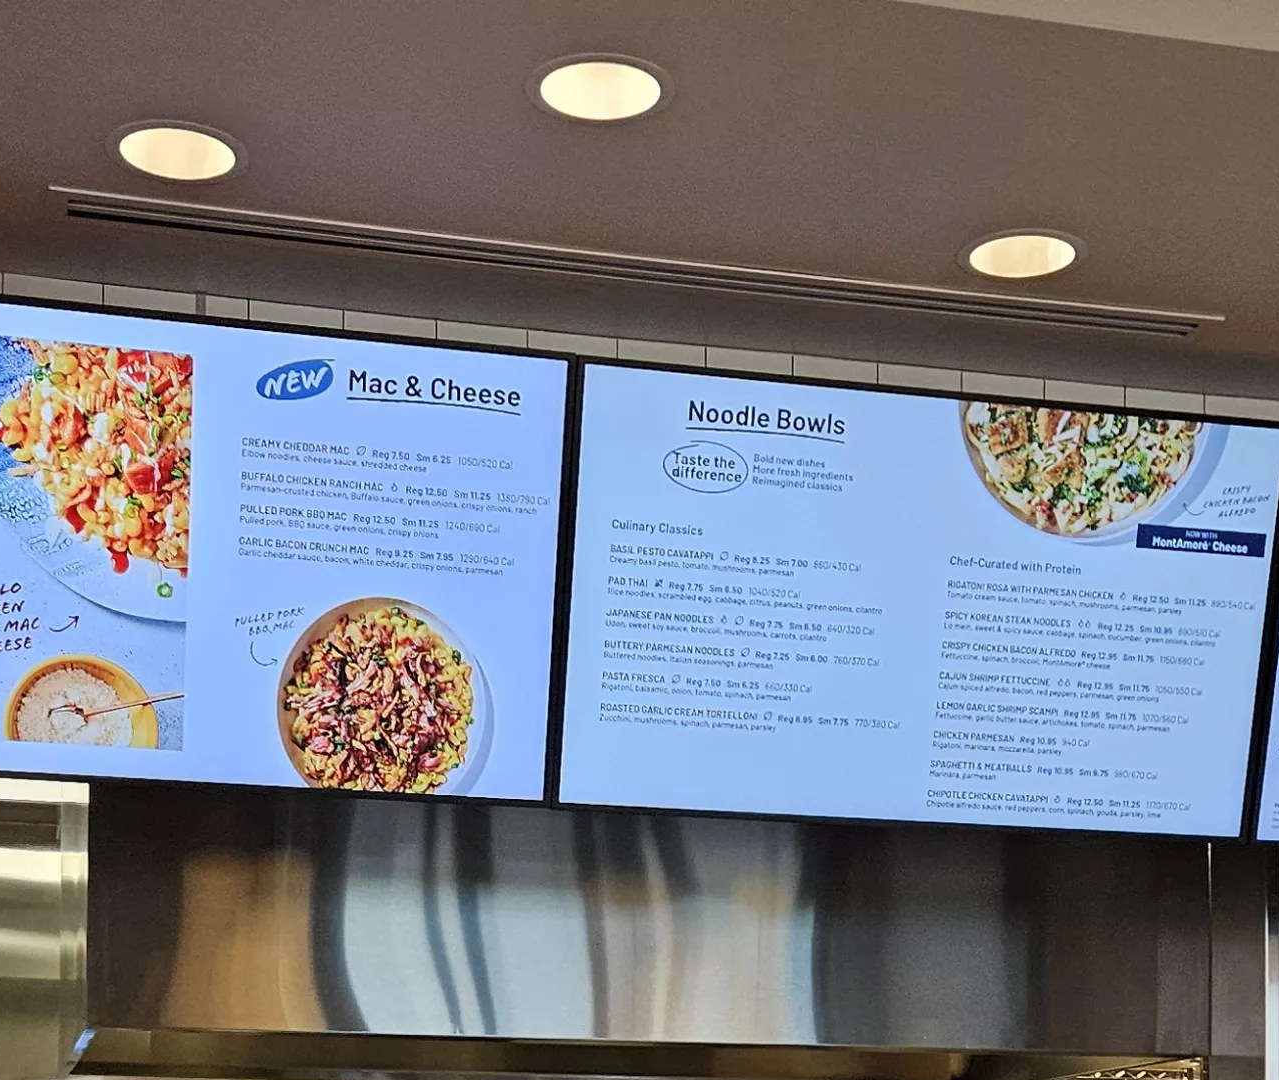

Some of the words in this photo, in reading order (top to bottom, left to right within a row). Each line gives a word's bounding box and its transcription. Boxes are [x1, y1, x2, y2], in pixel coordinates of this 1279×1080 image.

[264, 367, 326, 398] NEW
[349, 369, 398, 396] Mac
[405, 377, 422, 398] &
[431, 378, 521, 407] Cheese
[688, 400, 770, 428] Noodle
[777, 408, 845, 435] Bowls
[241, 437, 281, 448] CREAMY
[283, 440, 327, 453] CHEDDAR
[329, 445, 349, 455] MAC
[372, 449, 389, 461] Reg
[391, 450, 409, 461] 7.50
[674, 453, 710, 467] Taste
[714, 456, 735, 469] the
[753, 453, 774, 464] Bold
[775, 457, 794, 465] new
[796, 458, 825, 468] dishes
[672, 466, 742, 483] difference
[752, 464, 775, 475] More
[777, 466, 800, 477] fresh
[802, 469, 853, 481] ingredients
[241, 471, 284, 483] BUFFALO
[286, 474, 327, 487] CHICKEN
[329, 478, 361, 490] RANCH
[363, 481, 383, 492] MAC
[405, 485, 423, 497] Reg
[425, 487, 447, 497] 12.50
[752, 475, 805, 489] Reimagined
[806, 478, 842, 492] classics
[240, 503, 277, 515] PULLED
[279, 506, 304, 517] PORK
[326, 511, 347, 521] MAC
[353, 513, 371, 525] Reg
[372, 515, 395, 525] 12.50
[611, 518, 656, 534] Culinary
[658, 522, 703, 536] Classics
[238, 536, 273, 547] GARLIC
[275, 538, 307, 550] BACON
[309, 541, 347, 553] CRUNCH
[349, 545, 369, 555] MAC
[375, 547, 393, 559] Reg
[394, 549, 413, 558] 9.25
[610, 544, 634, 554] BASIL
[637, 546, 665, 556] PESTO
[666, 548, 713, 560] CAVATAPPI
[1212, 541, 1249, 554] Cheese
[949, 555, 1018, 570] Chef-Curated
[1020, 562, 1042, 572] with
[1045, 562, 1081, 575] Protein
[608, 576, 626, 585] PAD
[628, 577, 648, 588] THAI
[234, 611, 274, 627] PULLED
[277, 607, 304, 620] PORK
[605, 608, 652, 619] JAPANESE
[654, 611, 672, 621] PAN
[673, 613, 713, 623] NOODLES
[3, 617, 39, 632] MAC
[604, 639, 644, 650] BUTTERY
[645, 642, 693, 654] PARMESAN
[694, 646, 735, 657] NOODLES
[941, 641, 971, 650] CRISPY
[972, 643, 1008, 653] CHICKEN
[1009, 645, 1037, 655] BACON
[1038, 647, 1076, 658] ALFREDO
[602, 671, 629, 681] PASTA
[631, 673, 665, 683] FRESCA
[600, 703, 640, 713] ROASTED
[641, 705, 673, 715] GARLIC
[674, 707, 704, 717] CREAM
[706, 709, 757, 720] TORTELLONI
